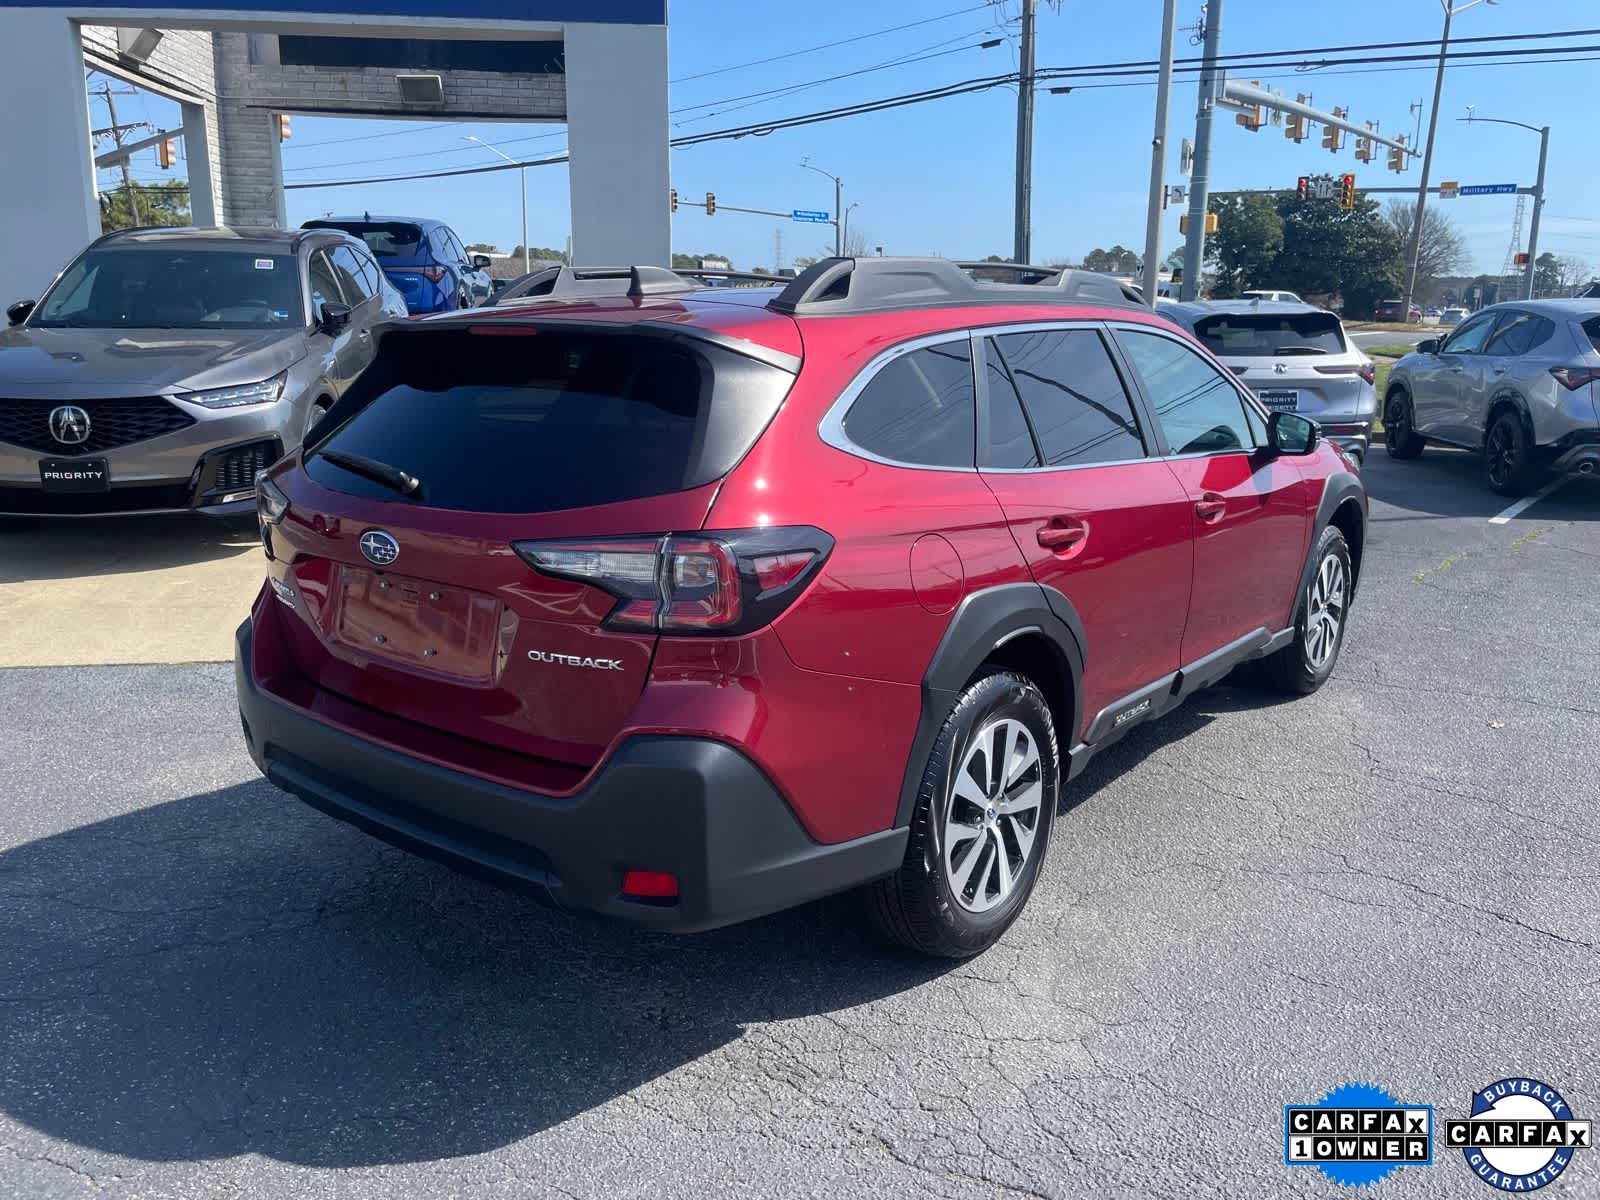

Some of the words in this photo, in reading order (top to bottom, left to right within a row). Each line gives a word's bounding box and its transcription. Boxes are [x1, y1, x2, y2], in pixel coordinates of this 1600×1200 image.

[1462, 186, 1494, 194] Military
[44, 471, 103, 480] PRIORITY
[527, 650, 625, 671] OUTBACK
